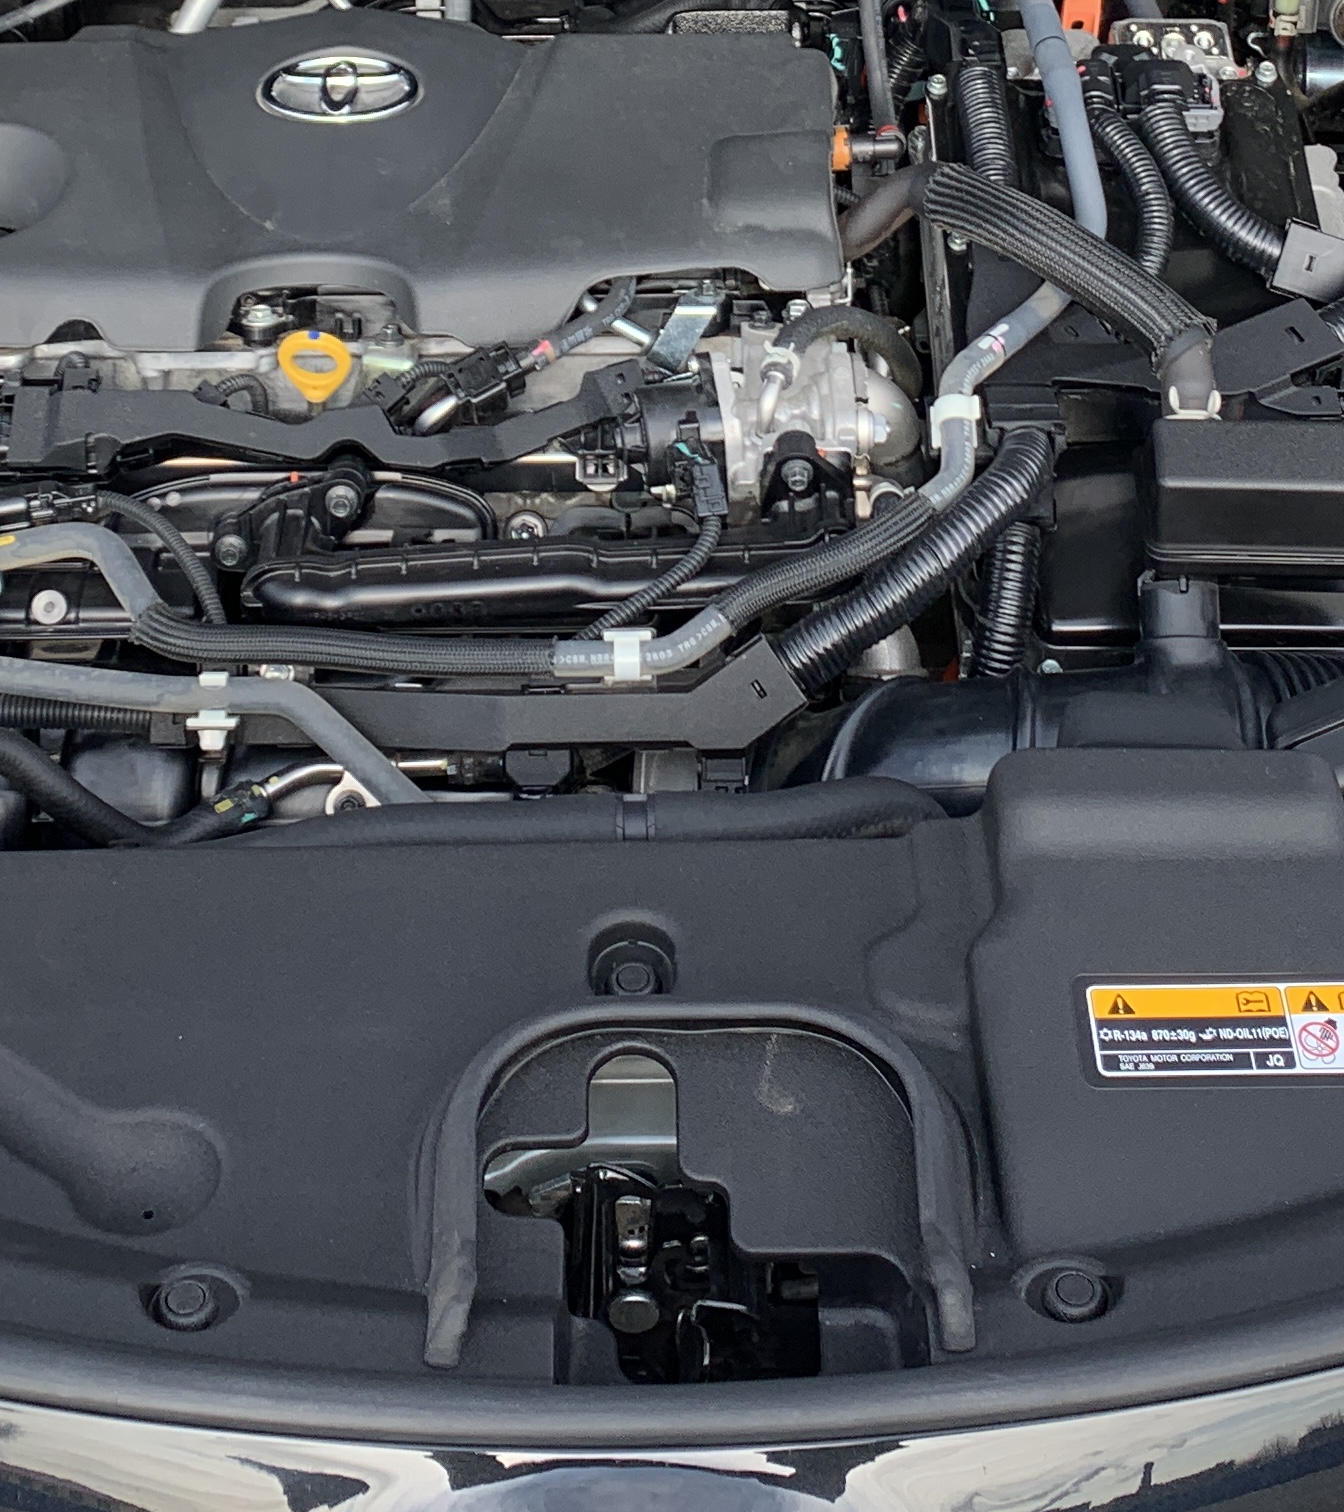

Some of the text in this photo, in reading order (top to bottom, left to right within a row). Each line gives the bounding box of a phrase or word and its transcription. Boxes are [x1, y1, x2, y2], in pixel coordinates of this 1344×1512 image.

[1113, 1026, 1289, 1044] R-134a 870±30g ND-OIL11(POE)
[1118, 1053, 1234, 1063] TOYOTA MOTOR CORPORATION
[1265, 1054, 1285, 1067] JQ
